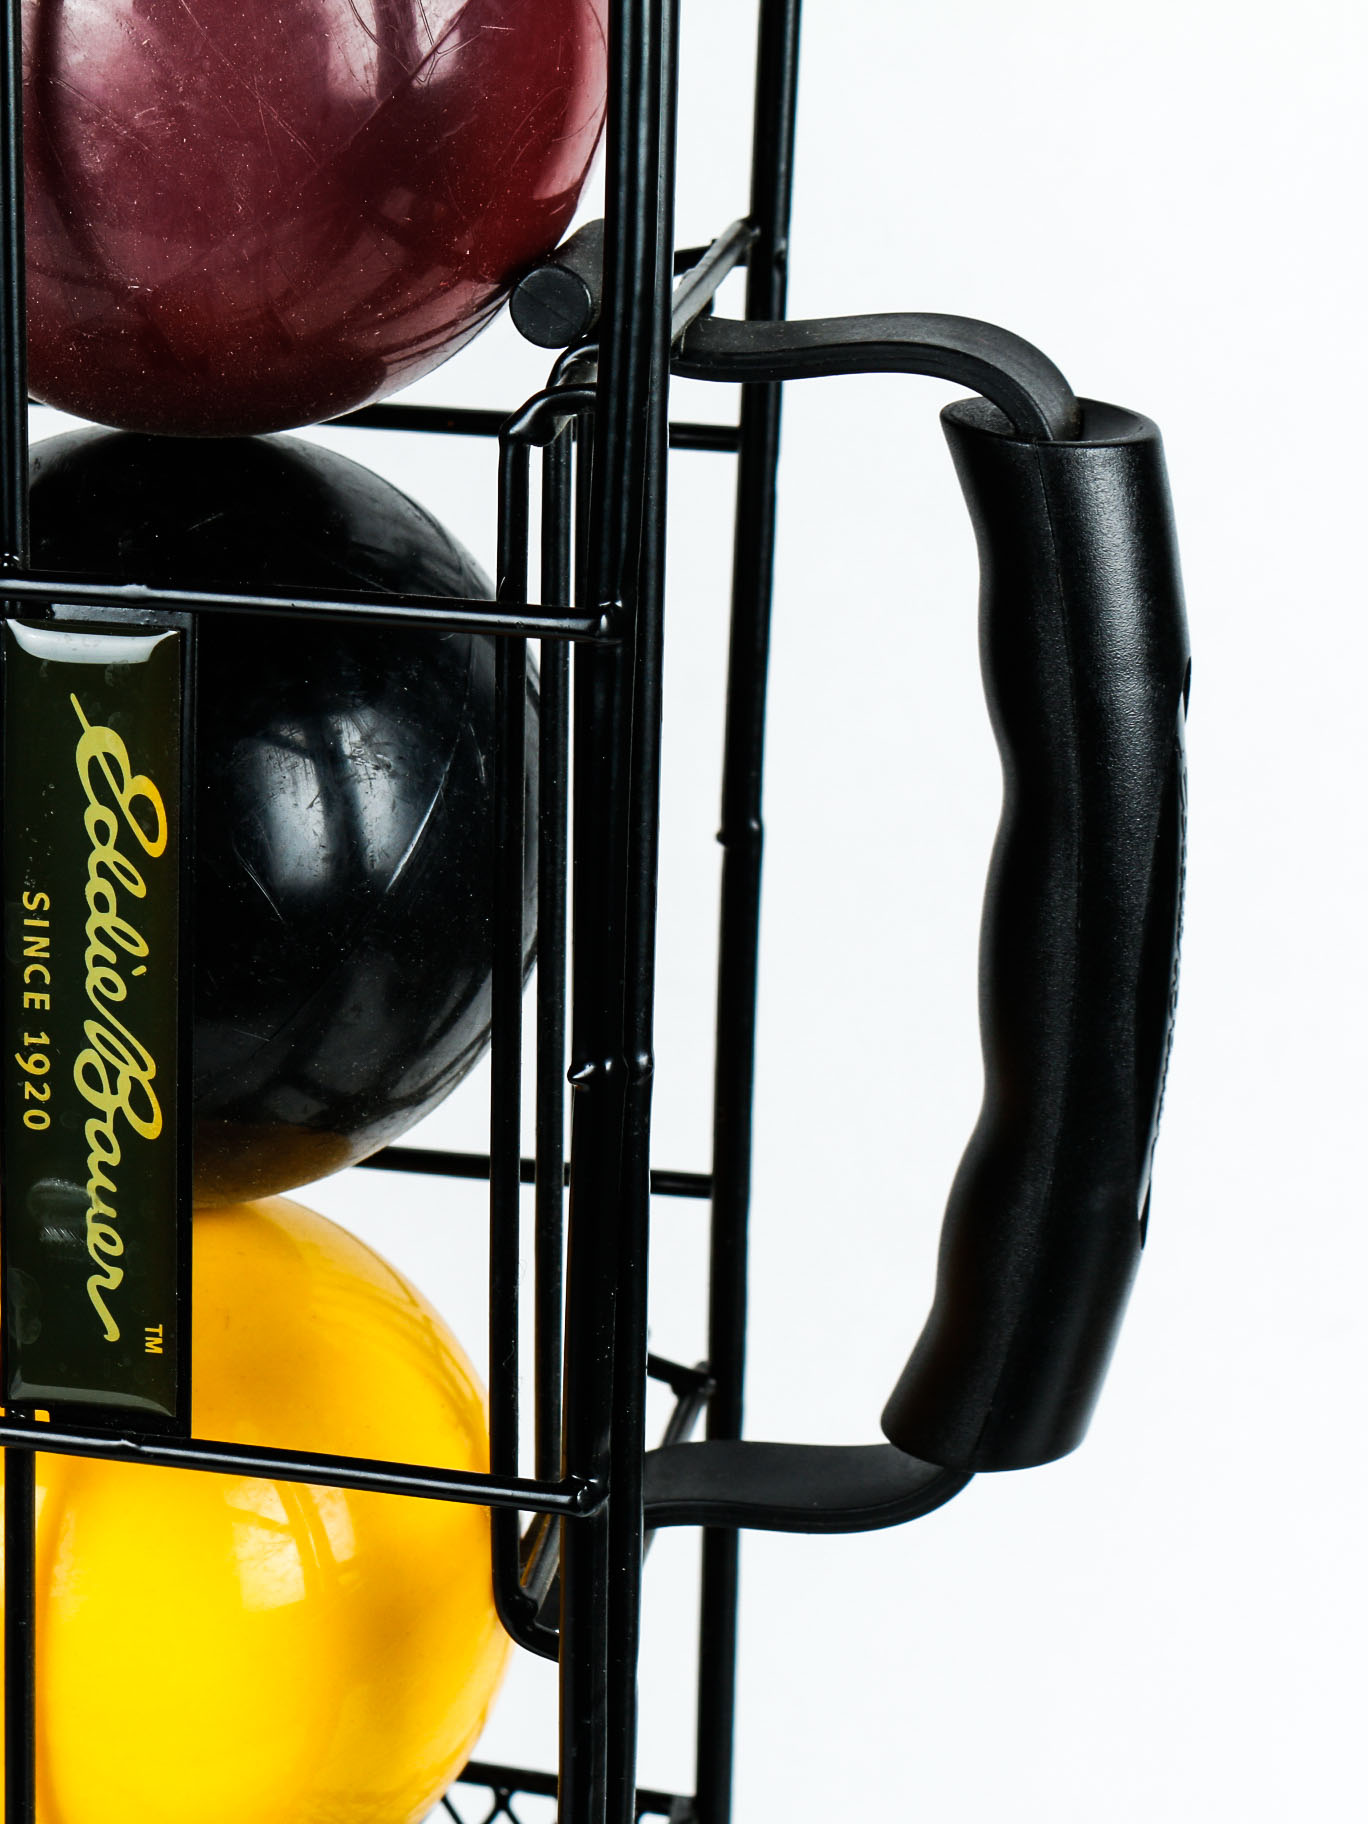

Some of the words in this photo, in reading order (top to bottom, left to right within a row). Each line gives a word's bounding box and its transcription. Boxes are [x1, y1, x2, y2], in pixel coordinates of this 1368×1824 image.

[70, 692, 168, 1017] Eddie
[22, 891, 51, 1011] SINCE
[14, 1031, 51, 1131] 1920
[73, 1019, 163, 1343] Bauer
[143, 1323, 164, 1355] TM
